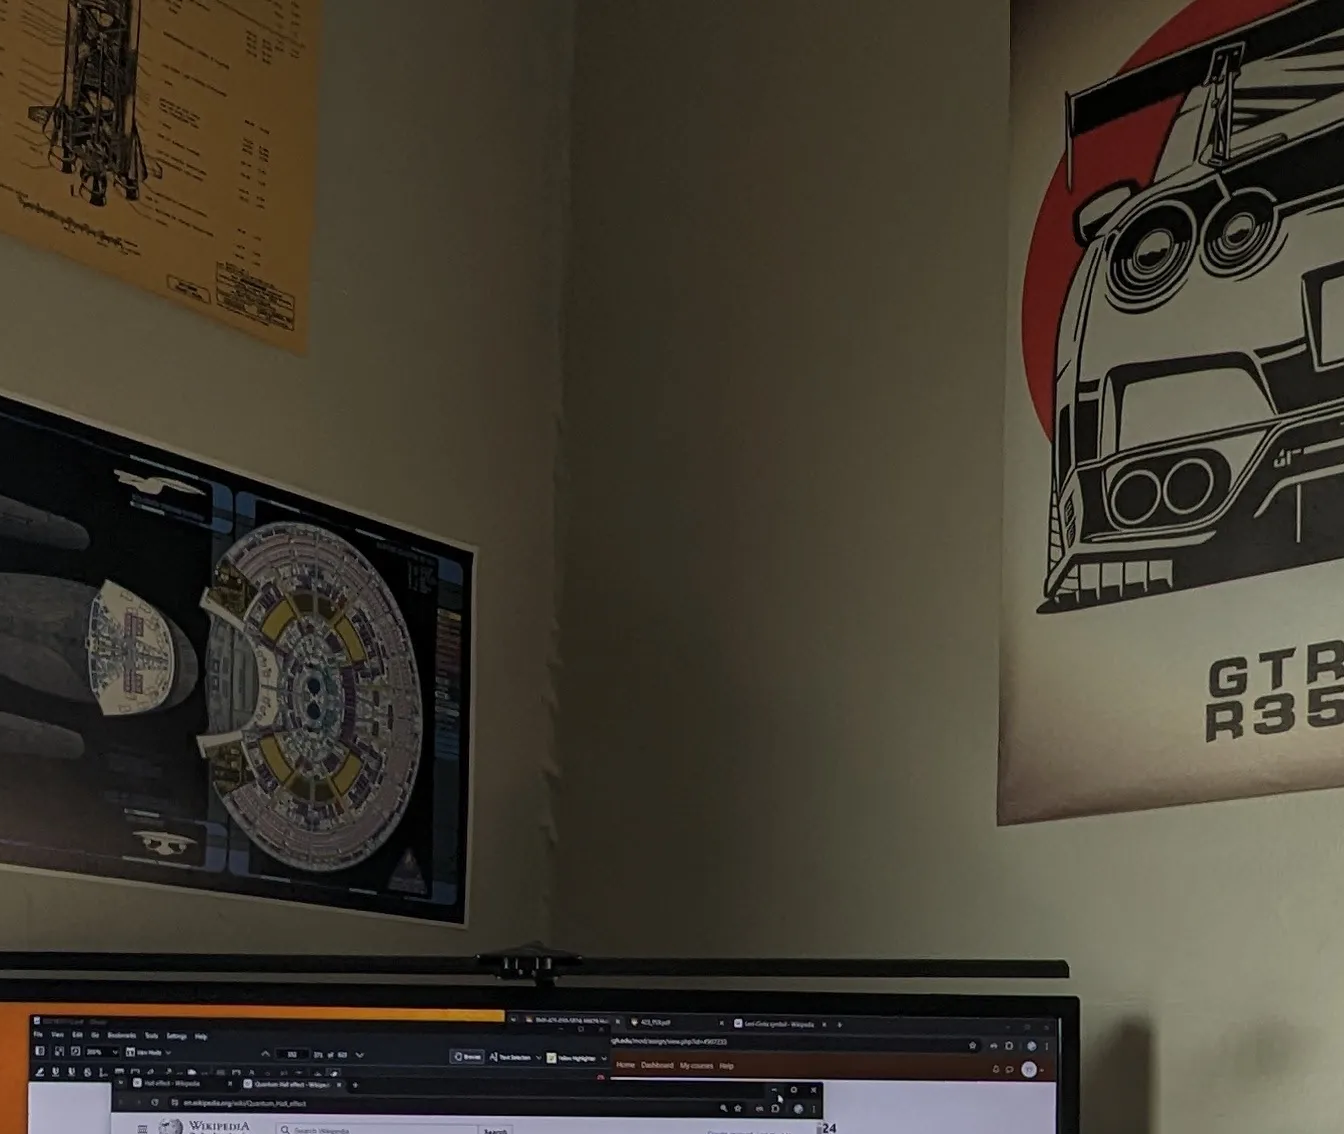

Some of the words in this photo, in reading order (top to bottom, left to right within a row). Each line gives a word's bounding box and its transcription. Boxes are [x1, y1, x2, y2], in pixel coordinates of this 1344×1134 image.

[195, 1032, 207, 1041] Help
[616, 1060, 635, 1070] Home
[641, 1060, 674, 1070] Dashboard
[680, 1061, 690, 1071] My
[691, 1062, 714, 1070] courses
[719, 1062, 735, 1072] Help
[823, 1123, 837, 1133] 24
